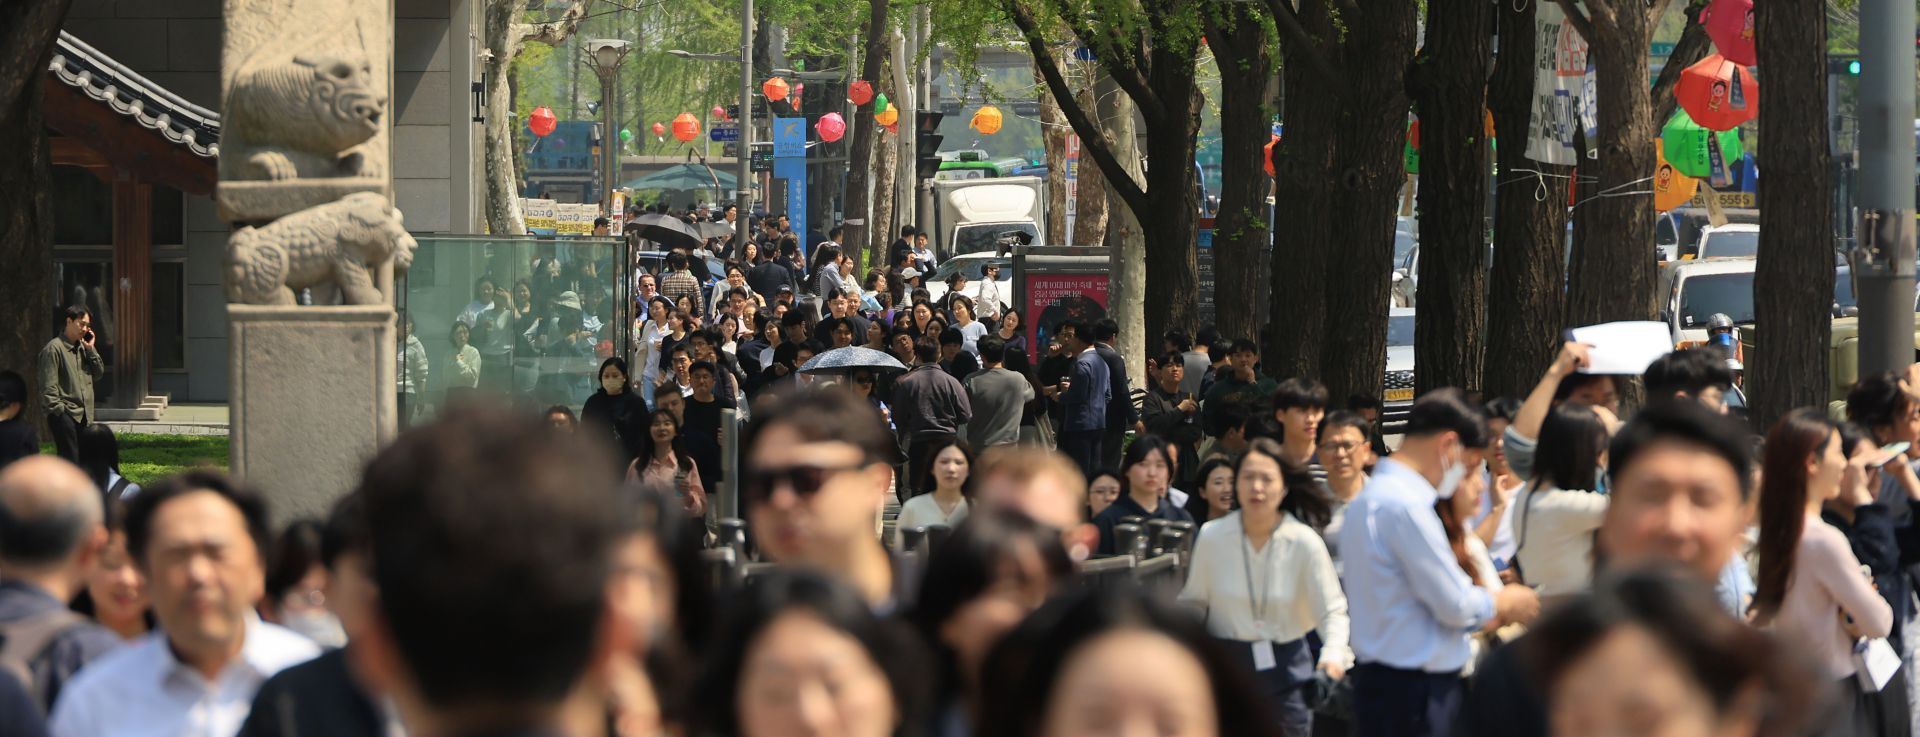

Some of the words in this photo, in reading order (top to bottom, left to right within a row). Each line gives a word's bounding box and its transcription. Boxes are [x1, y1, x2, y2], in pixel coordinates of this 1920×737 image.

[1034, 281, 1048, 289] 세계
[1049, 281, 1064, 289] 10대
[1064, 281, 1078, 289] 미식
